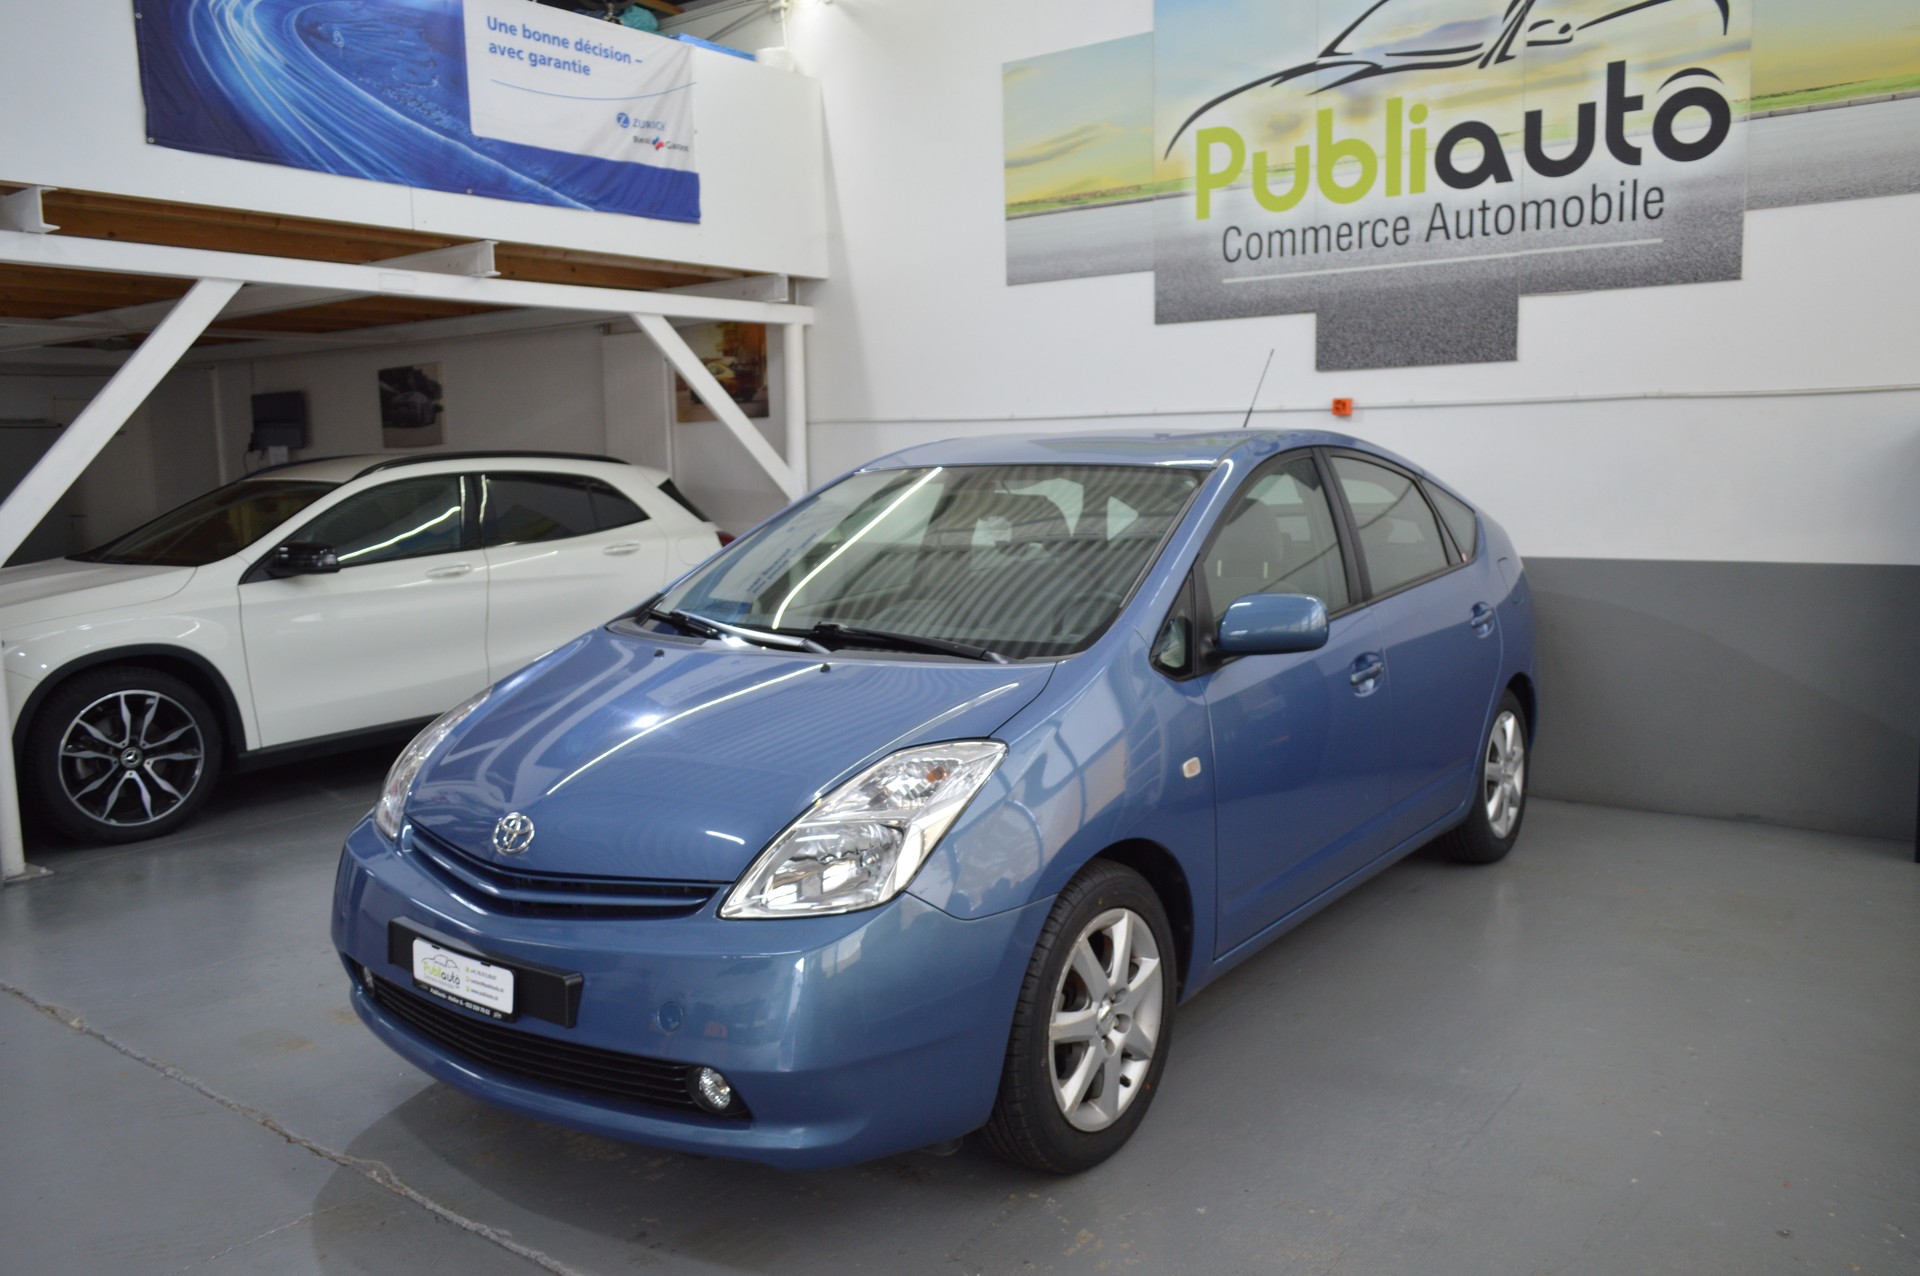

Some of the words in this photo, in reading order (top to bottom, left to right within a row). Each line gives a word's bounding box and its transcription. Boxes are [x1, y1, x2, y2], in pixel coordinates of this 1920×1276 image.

[487, 16, 518, 36] Une
[522, 24, 570, 49] bonne
[574, 38, 632, 65] décision
[489, 42, 524, 61] avec
[528, 52, 591, 76] garantie
[1195, 59, 1732, 220] Publiauto
[1222, 214, 1410, 264] Commerce
[1425, 179, 1665, 243] Automobile
